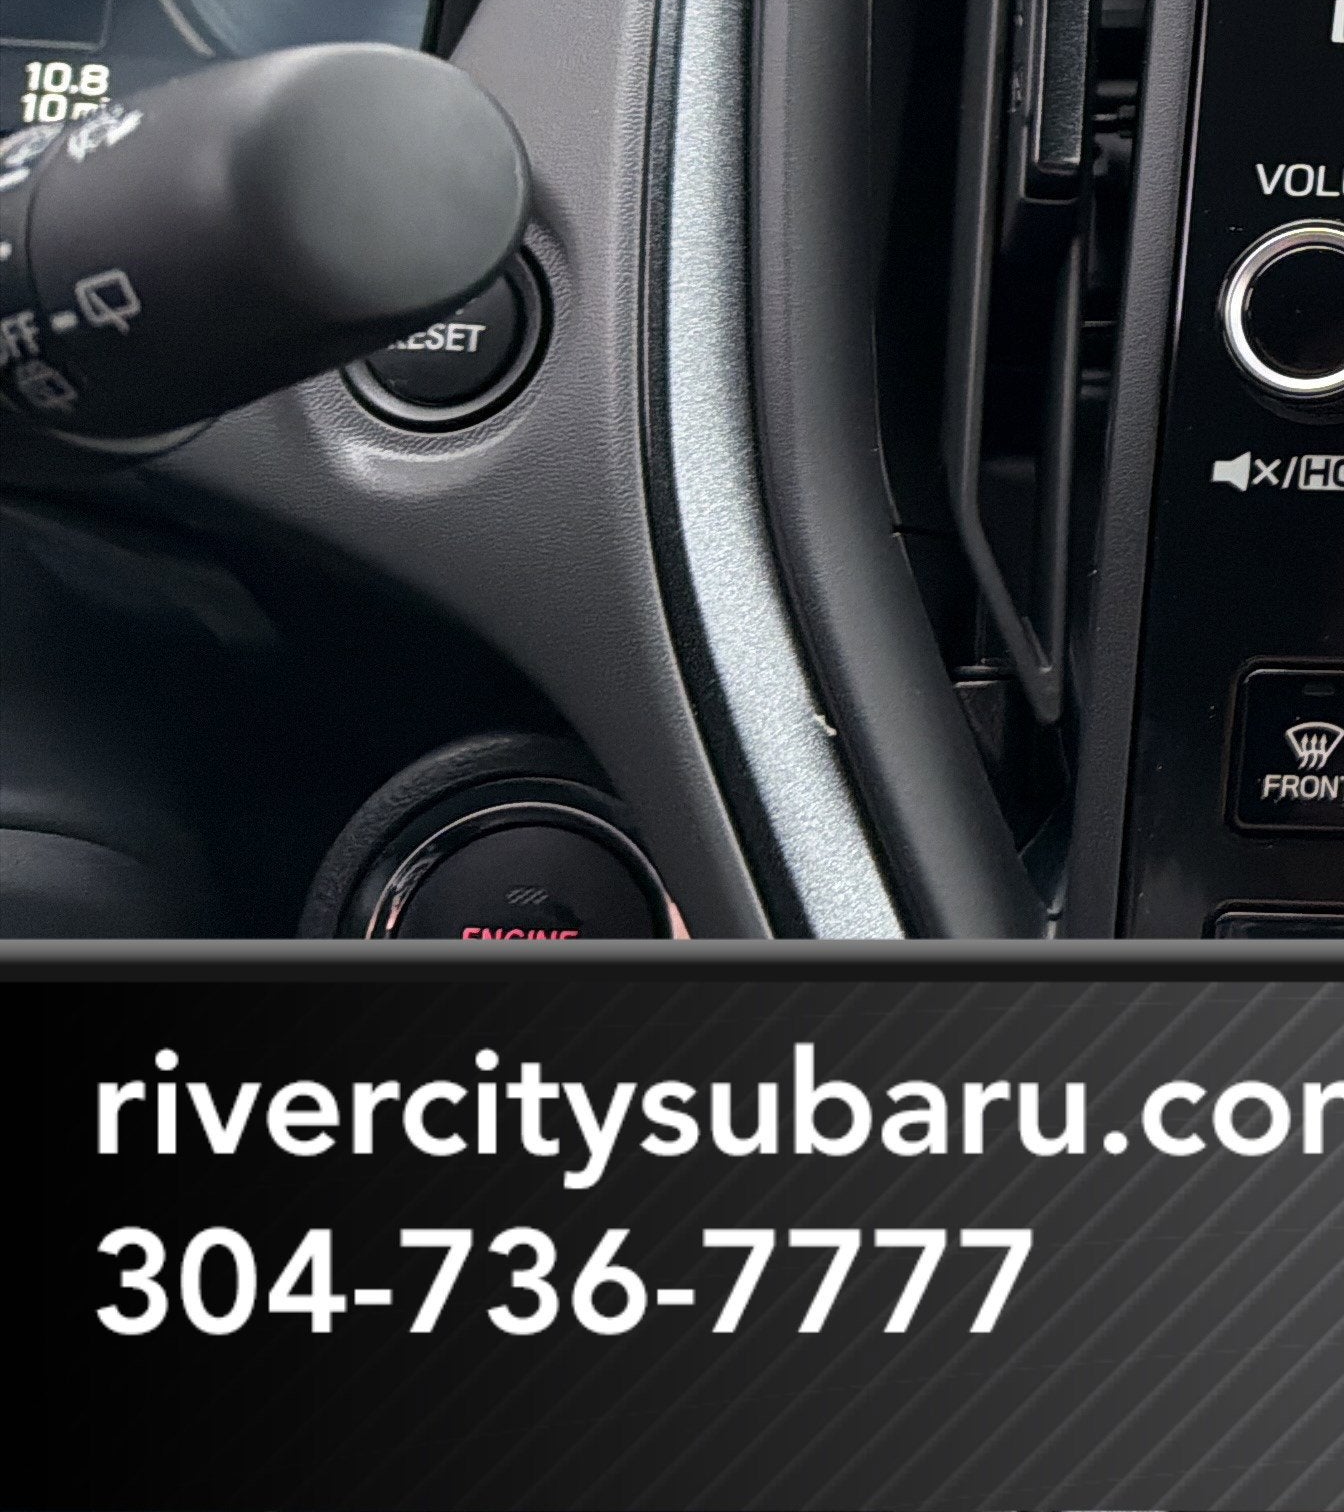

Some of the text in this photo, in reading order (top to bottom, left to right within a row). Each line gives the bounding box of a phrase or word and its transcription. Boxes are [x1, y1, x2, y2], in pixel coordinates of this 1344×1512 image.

[25, 61, 109, 96] 10.8
[21, 92, 68, 122] 10
[0, 310, 40, 368] FF
[387, 323, 486, 352] ESET
